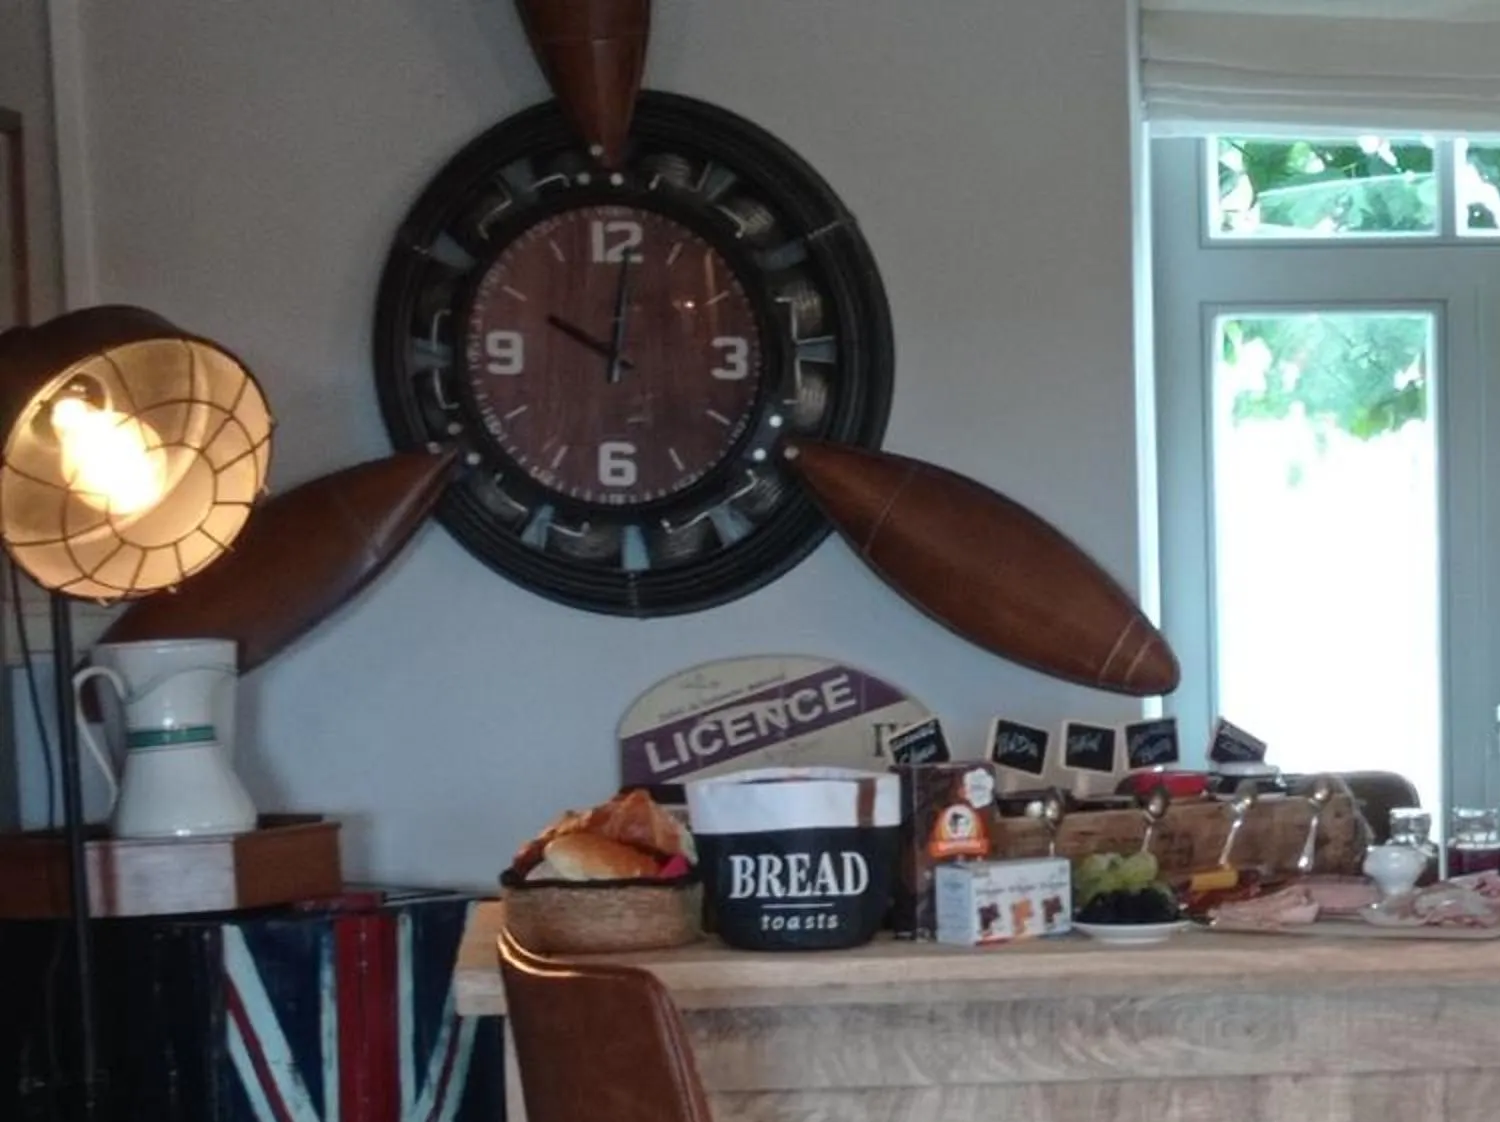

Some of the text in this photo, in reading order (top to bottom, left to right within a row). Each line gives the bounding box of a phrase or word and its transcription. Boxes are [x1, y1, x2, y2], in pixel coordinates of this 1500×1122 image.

[592, 220, 644, 264] 12
[485, 331, 524, 376] 9
[711, 336, 749, 380] 3
[598, 441, 637, 487] 6
[644, 672, 858, 775] LICENCE
[728, 851, 870, 899] BREAD
[760, 909, 840, 932] toasts
